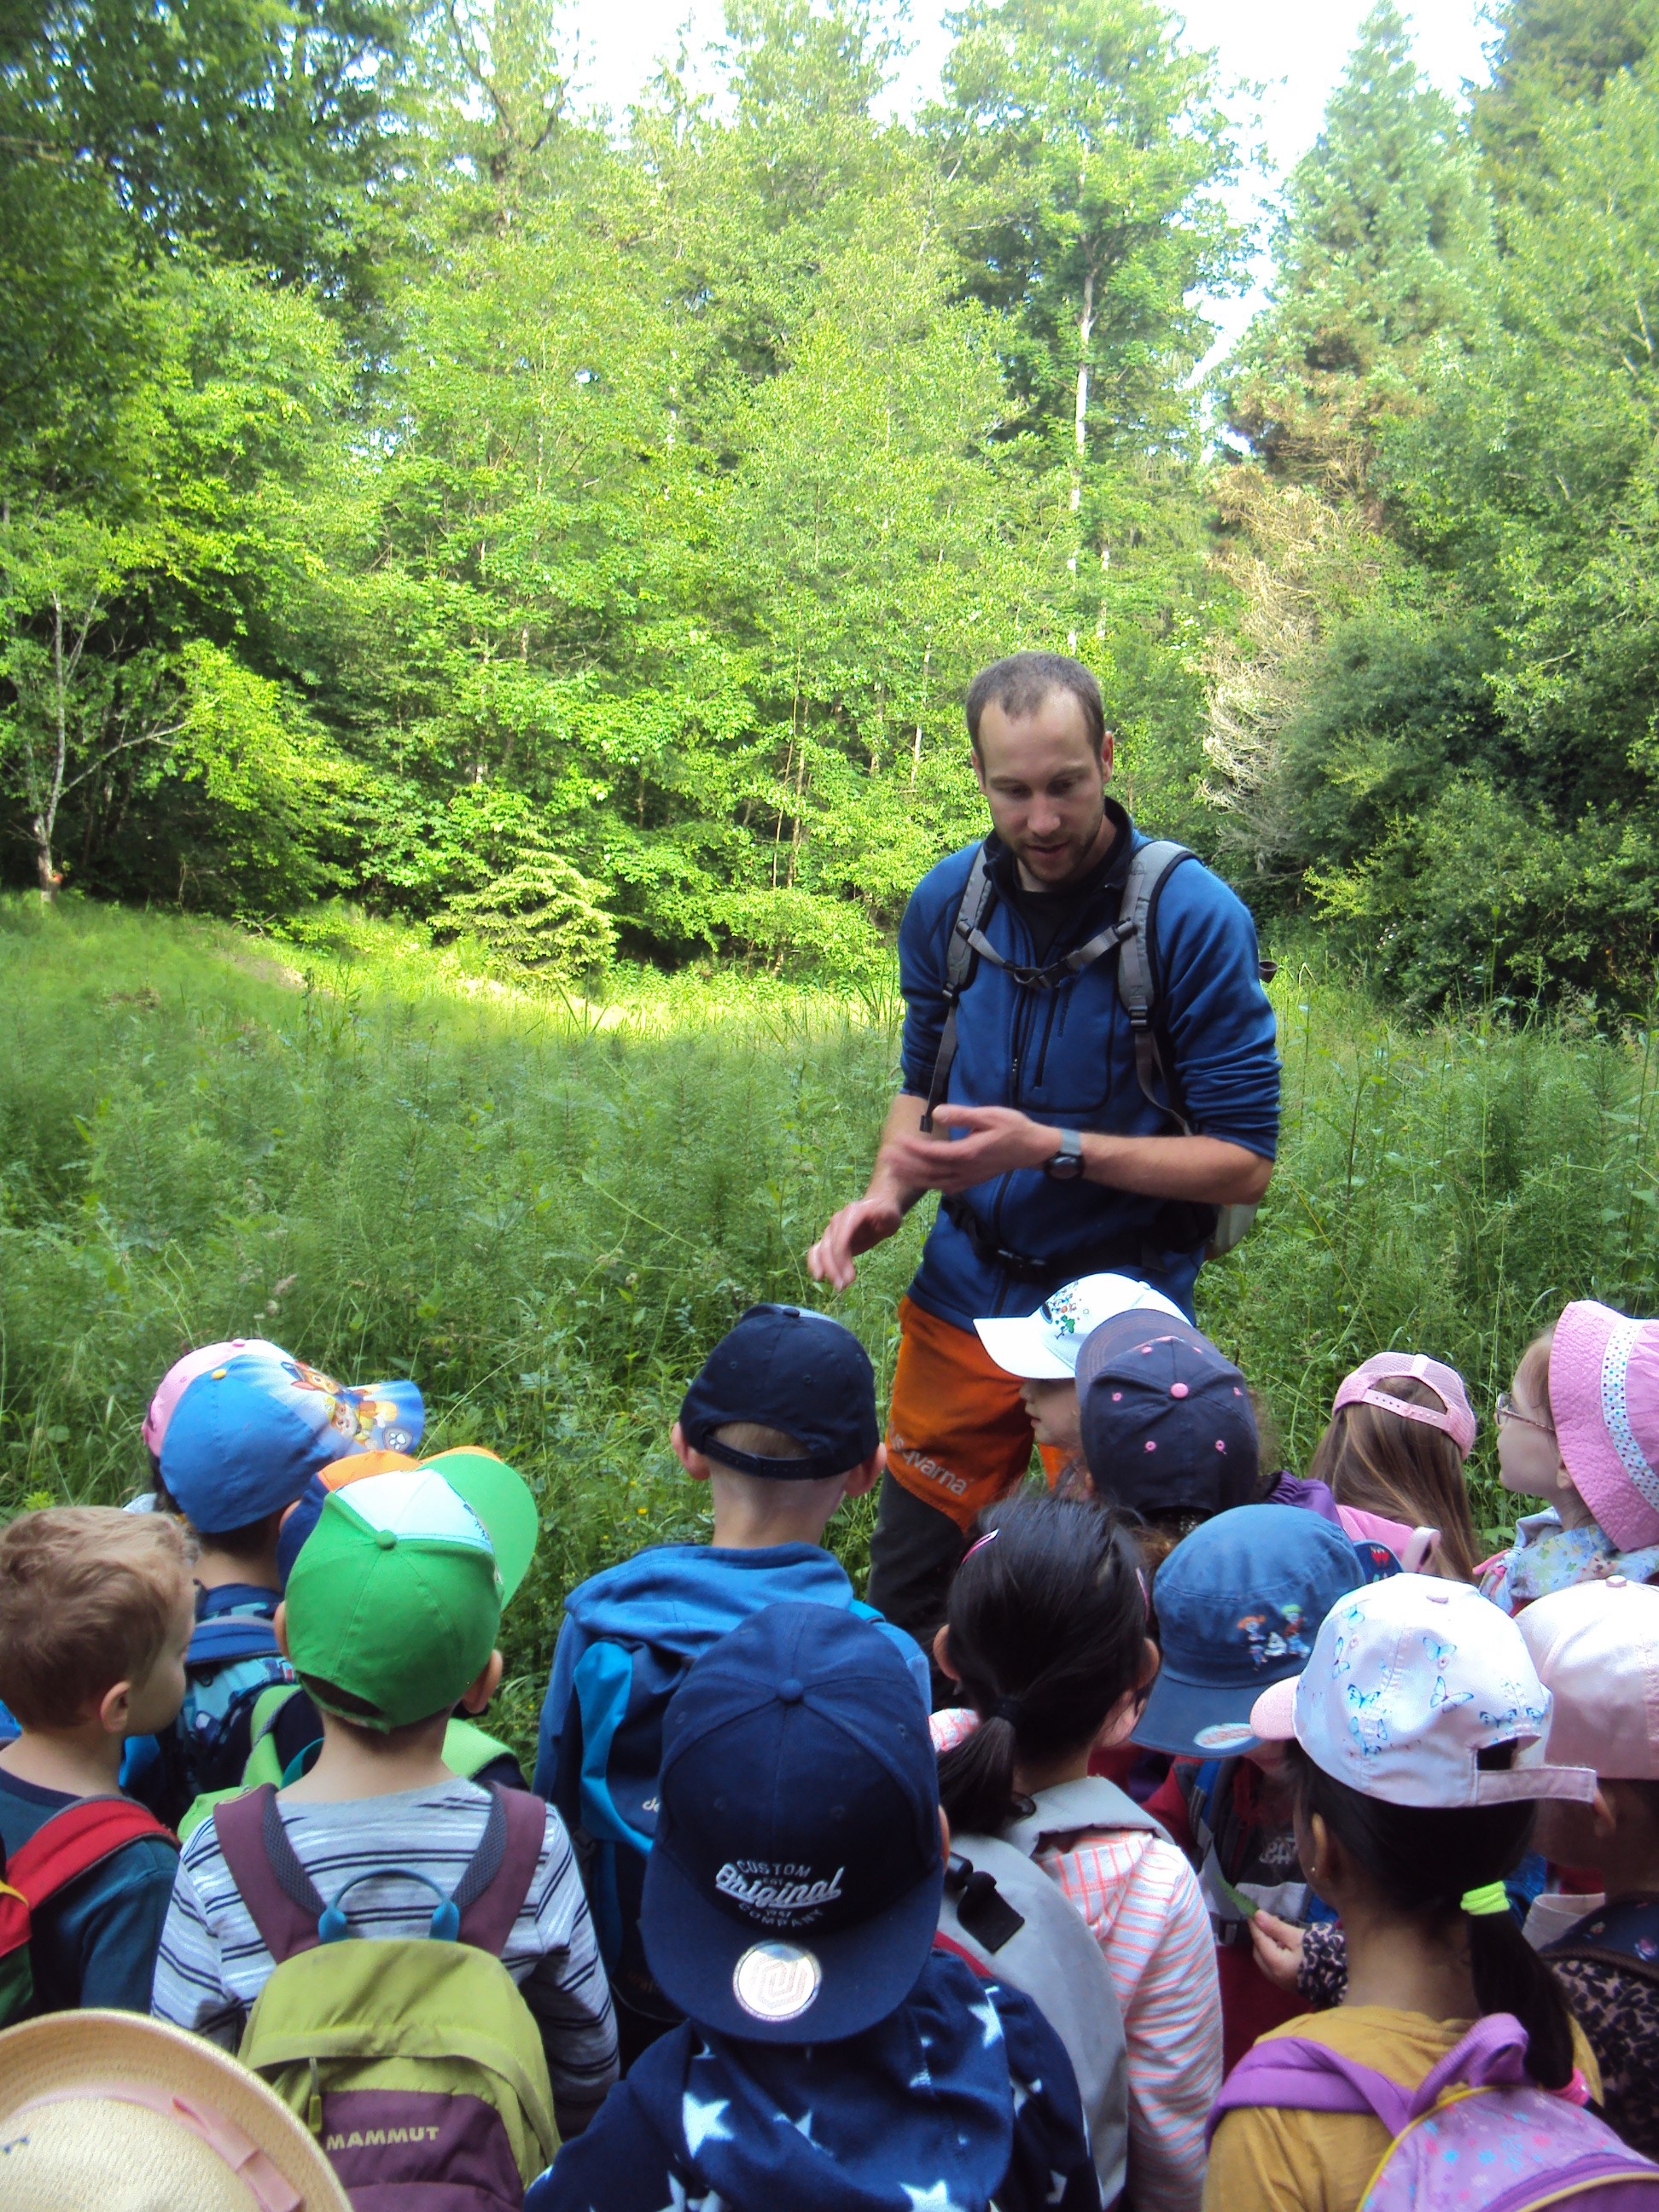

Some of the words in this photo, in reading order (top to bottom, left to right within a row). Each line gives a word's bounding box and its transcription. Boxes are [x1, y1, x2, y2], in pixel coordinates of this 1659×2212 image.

[736, 1860, 812, 1878] CUSTOM
[715, 1863, 845, 1908] Original
[738, 1902, 824, 1927] COMPANY
[326, 2126, 439, 2151] MAMMUT
